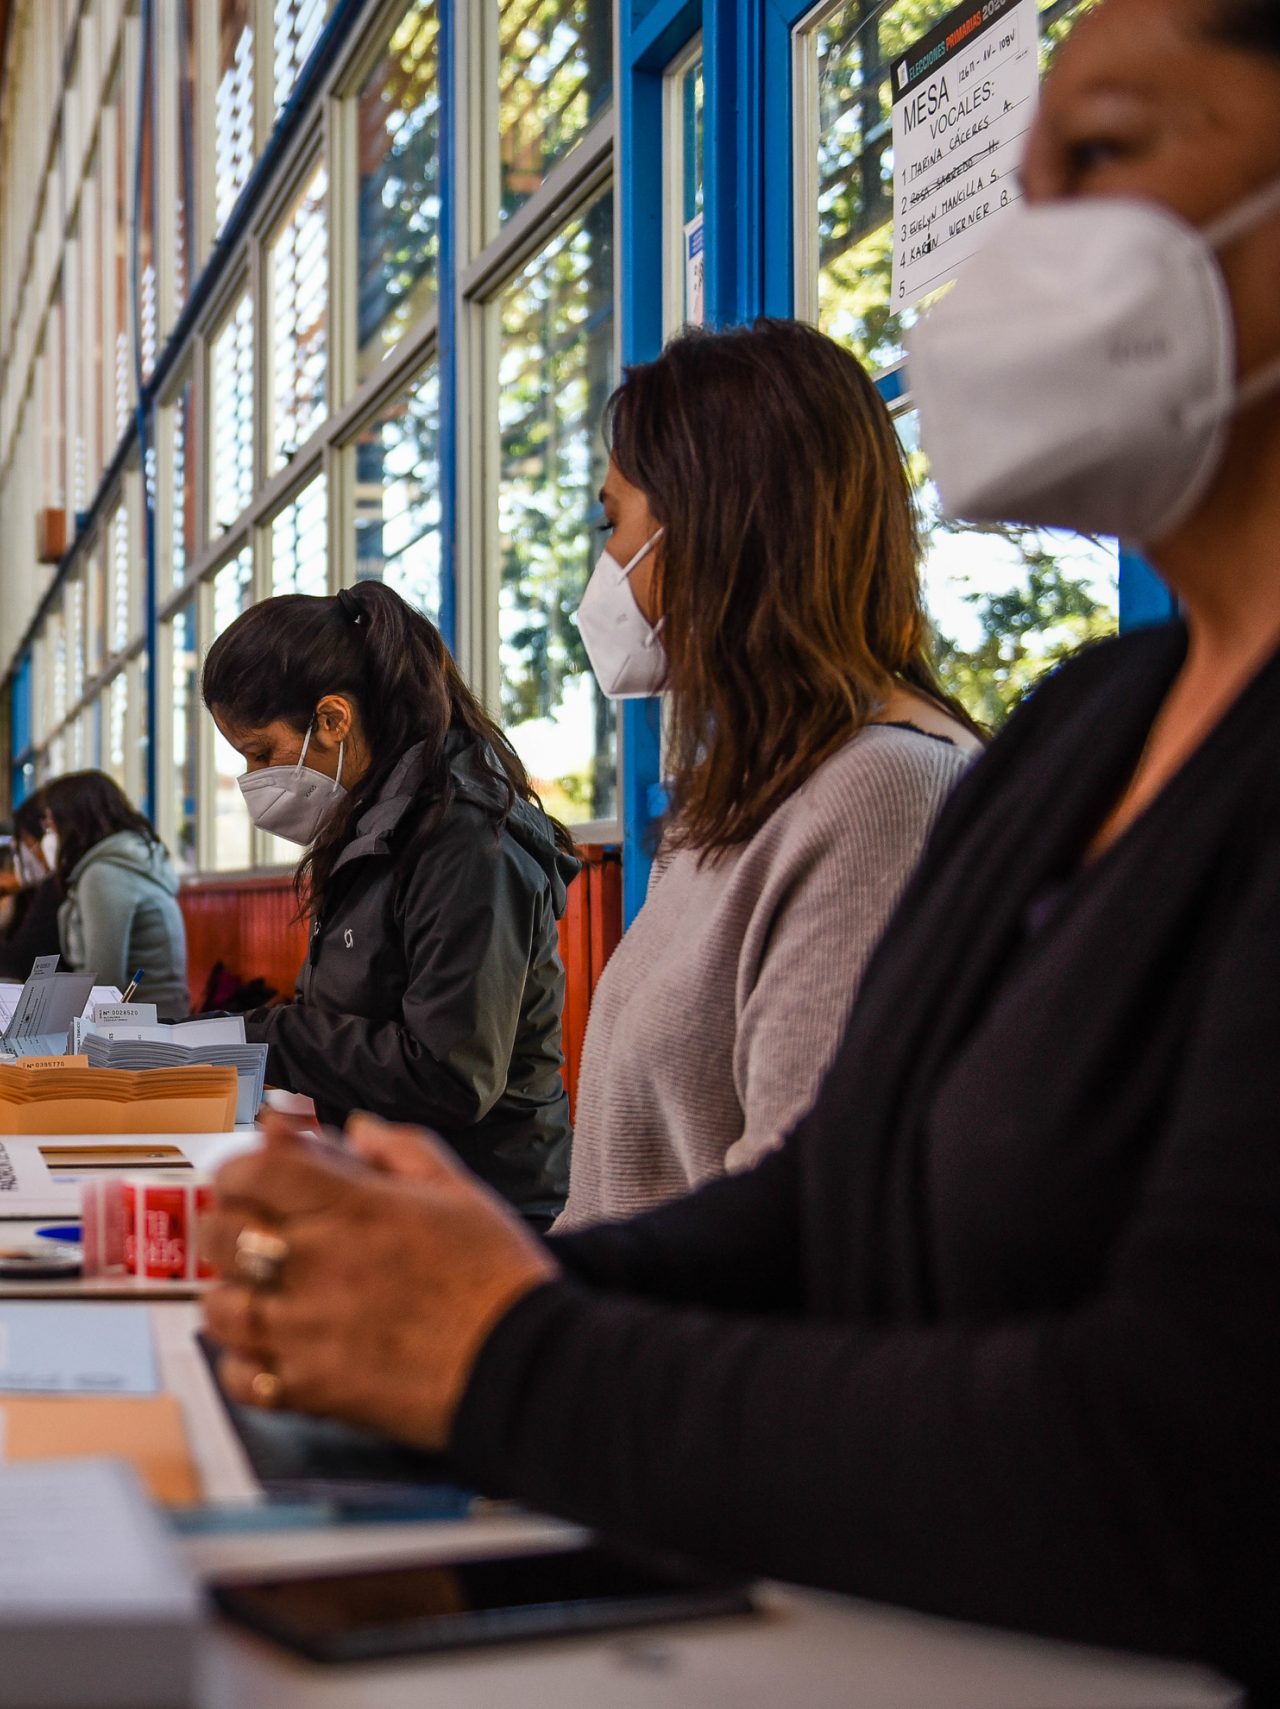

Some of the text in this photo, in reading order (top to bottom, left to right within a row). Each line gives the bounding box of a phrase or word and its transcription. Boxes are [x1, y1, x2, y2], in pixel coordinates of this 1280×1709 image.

[909, 41, 946, 80] ELECCIONES
[945, 11, 983, 51] PRIMARIAS
[903, 76, 950, 135] MESA
[929, 81, 995, 139] VOCALES:
[902, 169, 907, 186] 1
[901, 197, 908, 215] 2
[900, 251, 906, 269] 4
[949, 202, 989, 237] WERNER
[901, 225, 907, 242] 3
[899, 280, 906, 298] 5
